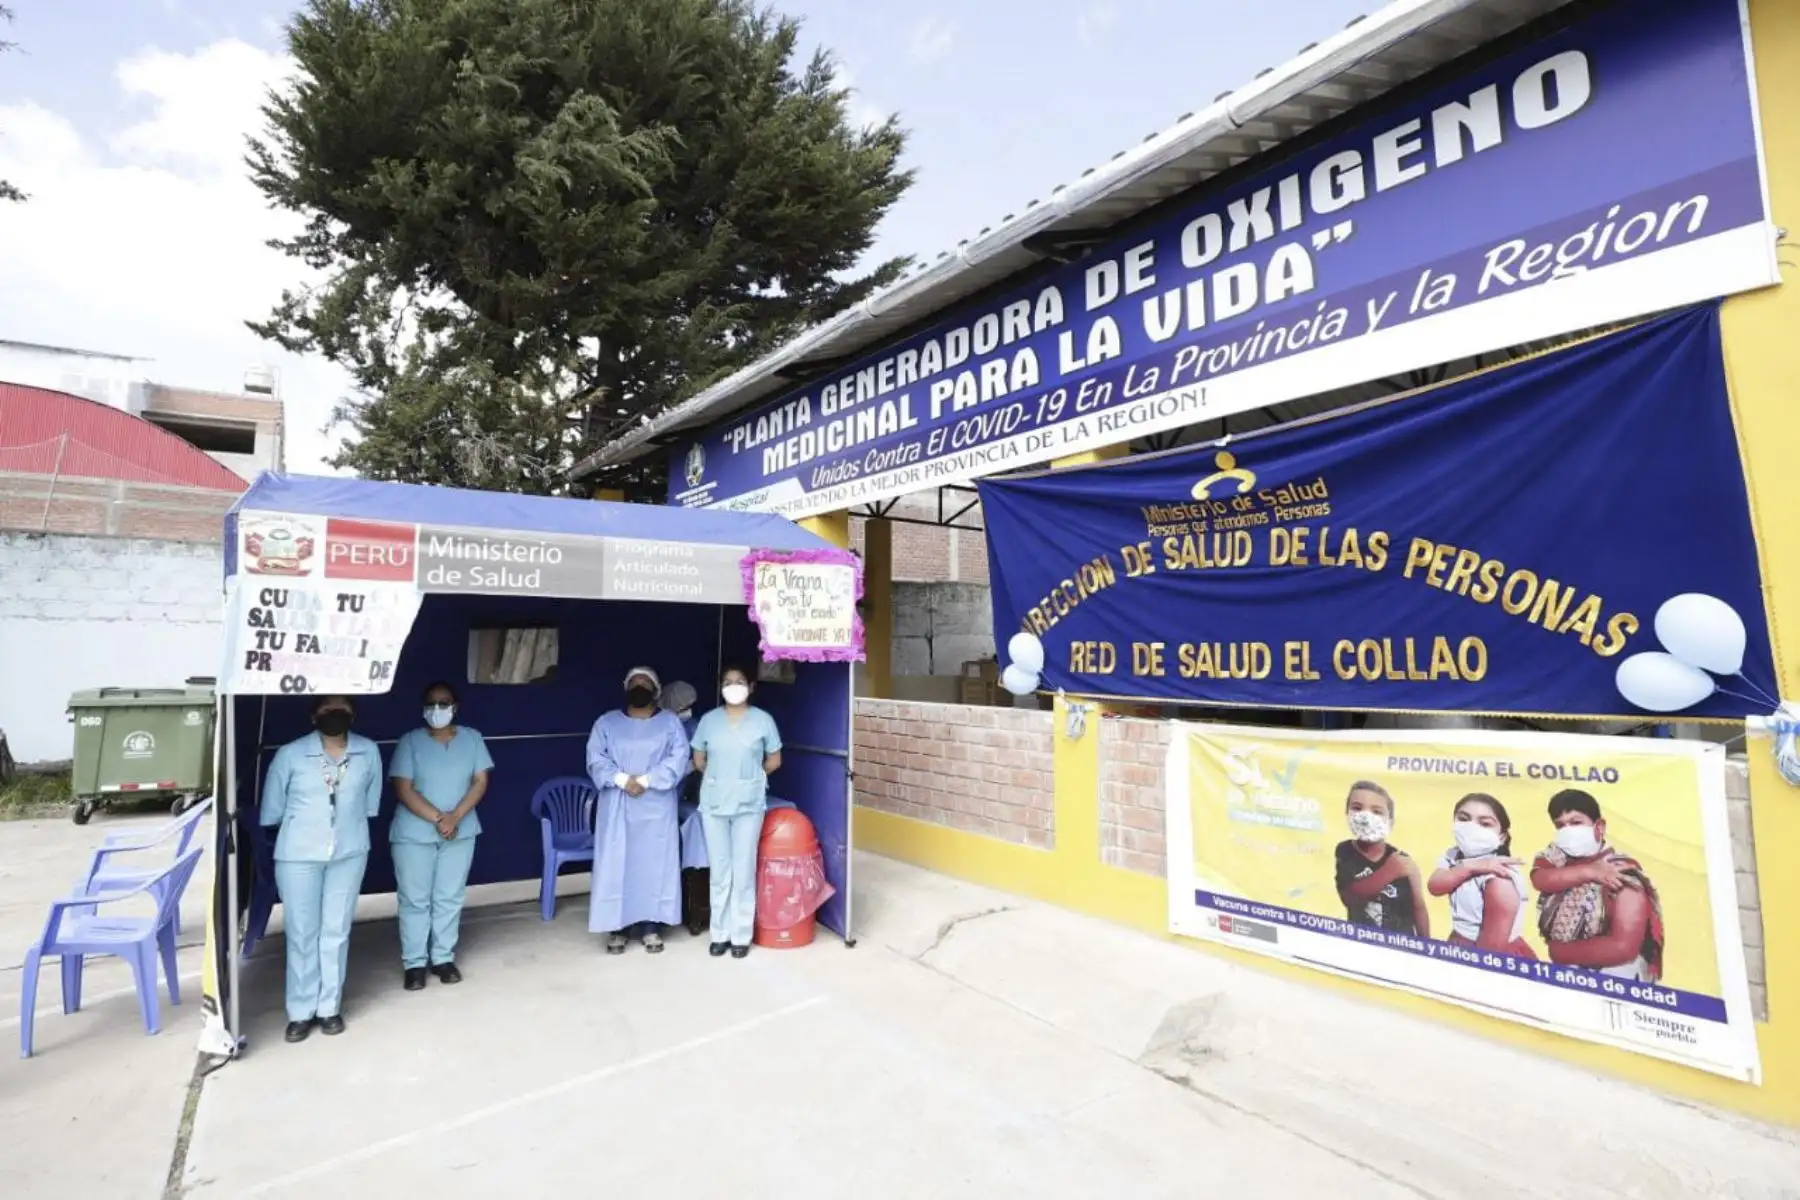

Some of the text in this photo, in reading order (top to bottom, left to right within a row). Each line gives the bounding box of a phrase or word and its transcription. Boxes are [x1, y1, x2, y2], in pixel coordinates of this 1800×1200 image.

[821, 285, 1064, 417] GENERADORA
[1085, 240, 1156, 312] DE
[1180, 49, 1591, 269] OXIGENO
[811, 193, 1710, 489] Unidos Contra El COVID-19 En La Provincia y la Region
[763, 393, 918, 476] MEDICINAL
[930, 346, 1039, 420] PARA
[1059, 315, 1121, 376] LA
[851, 482, 866, 496] LA
[869, 468, 920, 491] MEJOR
[924, 441, 1019, 481] PROVINCIA
[1026, 431, 1055, 458] DE
[1063, 422, 1090, 443] LA
[1098, 386, 1208, 433] REGIÓN!
[1140, 476, 1329, 523] Ministerio de Salud
[1147, 521, 1190, 537] Personas
[1275, 502, 1332, 523] Personas
[428, 535, 562, 565] Ministerio
[614, 560, 699, 575] Articulado
[426, 564, 541, 589] de Salud
[613, 579, 703, 596] Nutricional
[1120, 541, 1156, 577] DE
[1162, 530, 1252, 570] SALUD
[1269, 526, 1310, 567] DE
[1318, 526, 1389, 572] LAS
[1403, 537, 1639, 657] PERSONAS
[336, 593, 366, 613] TU
[255, 630, 287, 651] TU
[1069, 635, 1488, 682] RED DE SALUD EL COLLAO
[1387, 755, 1619, 784] PROVINCIA EL COLLAO
[1212, 895, 1677, 1007] Vacuna contra la COVID-19 para niñas y niños de 5 a 11 años de edad
[1633, 1010, 1696, 1033] Siempre
